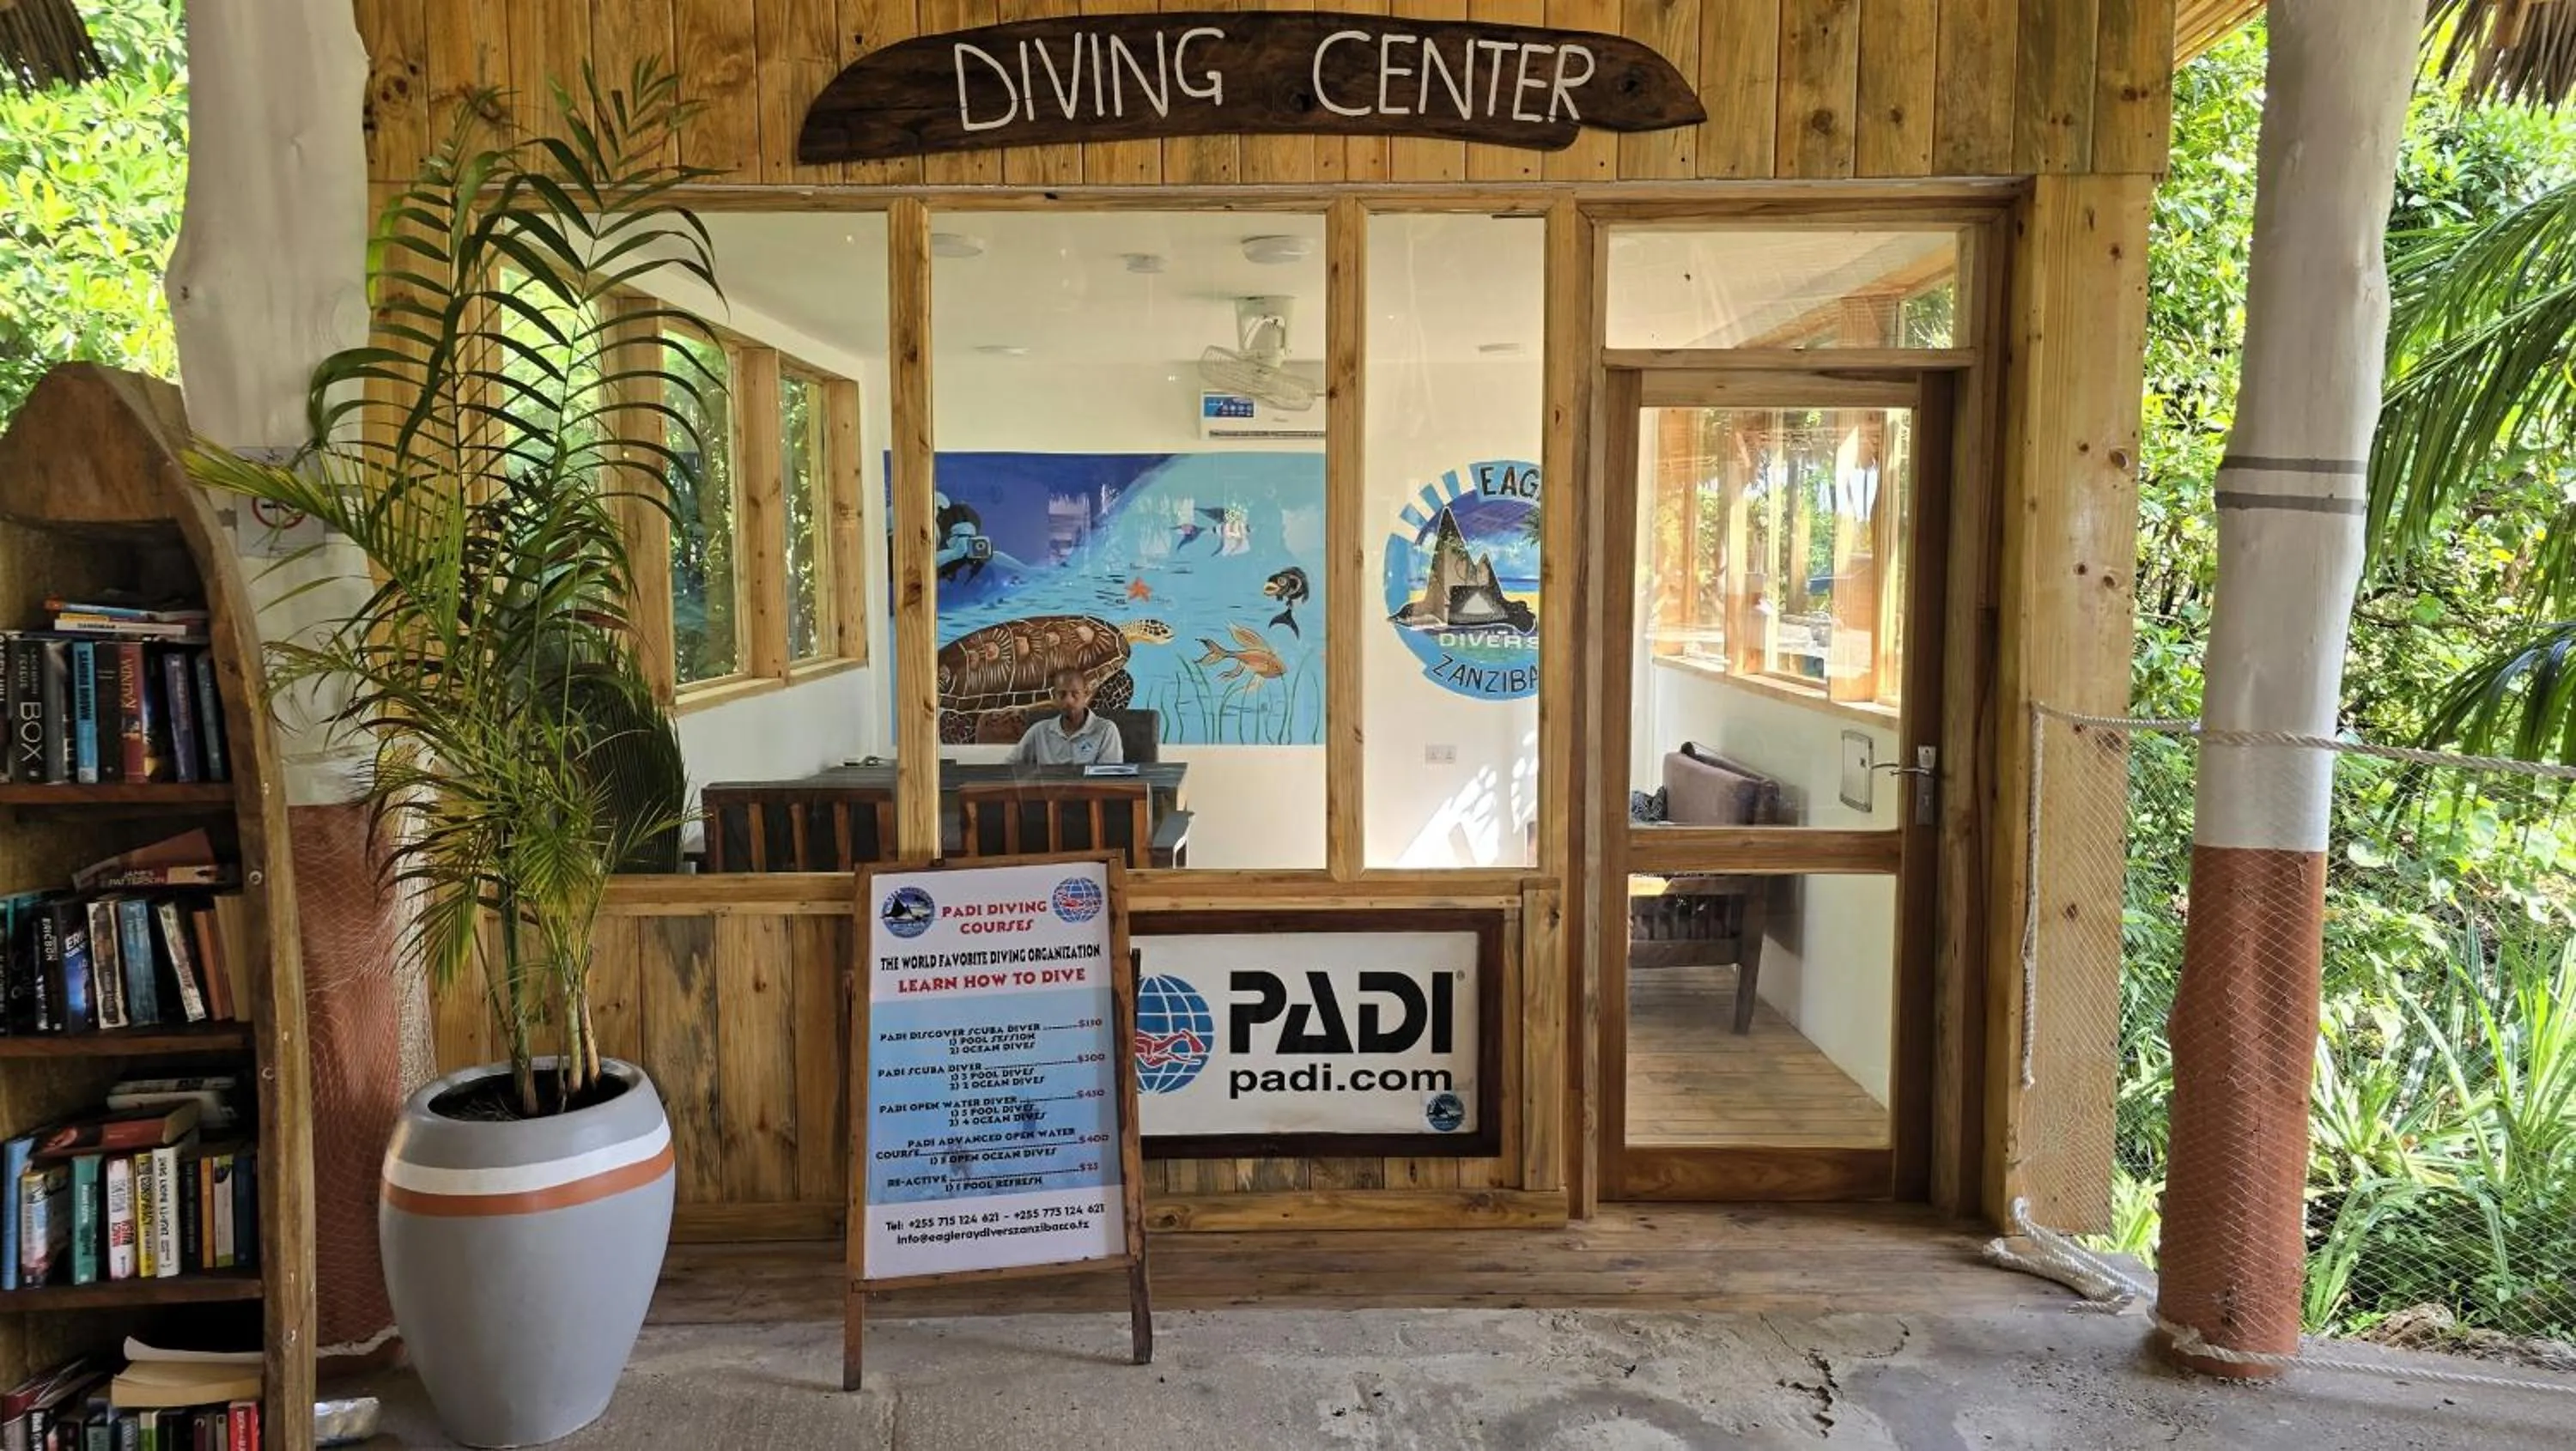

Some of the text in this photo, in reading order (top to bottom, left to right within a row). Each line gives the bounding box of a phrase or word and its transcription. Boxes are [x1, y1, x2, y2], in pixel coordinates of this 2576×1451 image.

[955, 27, 1595, 131] DIVING CENTER
[1479, 466, 1540, 500] EAG
[1439, 632, 1539, 649] DIVERS
[20, 701, 42, 762] BOX
[942, 901, 1048, 917] PADI DIVING
[960, 919, 1034, 935] COURSES
[880, 943, 1101, 971] THE WORLD FAVORITE DIVING ORGANIZATION
[898, 968, 1086, 993] LEARN HOW TO DIVE
[1230, 971, 1454, 1054] PADI
[880, 1033, 907, 1041] PADI
[910, 1029, 964, 1040] DISCOVER
[968, 1026, 1004, 1035] SCUBA
[1007, 1023, 1040, 1033] DIVER
[961, 1036, 988, 1045] POOL
[991, 1033, 1036, 1043] SESSION
[950, 1041, 1036, 1055] 2) OCEAN DIVES
[878, 1068, 905, 1078] PADI
[908, 1065, 945, 1075] SCUBA
[948, 1062, 981, 1072] DIVER
[970, 1071, 999, 1080] POOL
[1002, 1067, 1035, 1078] DIVES
[971, 1078, 1010, 1089] OCEAN
[1013, 1076, 1045, 1086] DIVES
[1230, 1063, 1453, 1100] padi.com
[879, 1104, 907, 1114] PADI
[910, 1102, 939, 1111] OPEN
[943, 1098, 980, 1108] WATER
[983, 1096, 1018, 1106] DIVER
[970, 1106, 999, 1115] POOL
[1003, 1102, 1035, 1114] DIVES
[972, 1114, 1011, 1126] OCEAN
[1013, 1112, 1046, 1122] DIVES
[908, 1127, 1075, 1148] PADI ADVANCED OPEN WATER
[876, 1149, 920, 1161] COURSE
[950, 1153, 979, 1163] OPEN
[981, 1150, 1021, 1161] OCEAN
[1024, 1146, 1057, 1157] DIVES
[887, 1175, 947, 1188] RE-ACTIVE
[963, 1181, 993, 1191] POOL
[996, 1176, 1042, 1187] REFRESH
[885, 1220, 904, 1231] Tel:
[909, 1217, 934, 1229] +255
[938, 1216, 956, 1227] 715
[958, 1214, 978, 1225] 124
[981, 1211, 999, 1223] 621
[1014, 1208, 1040, 1220] +255
[1065, 1205, 1084, 1216] 124
[1088, 1203, 1105, 1214] 621
